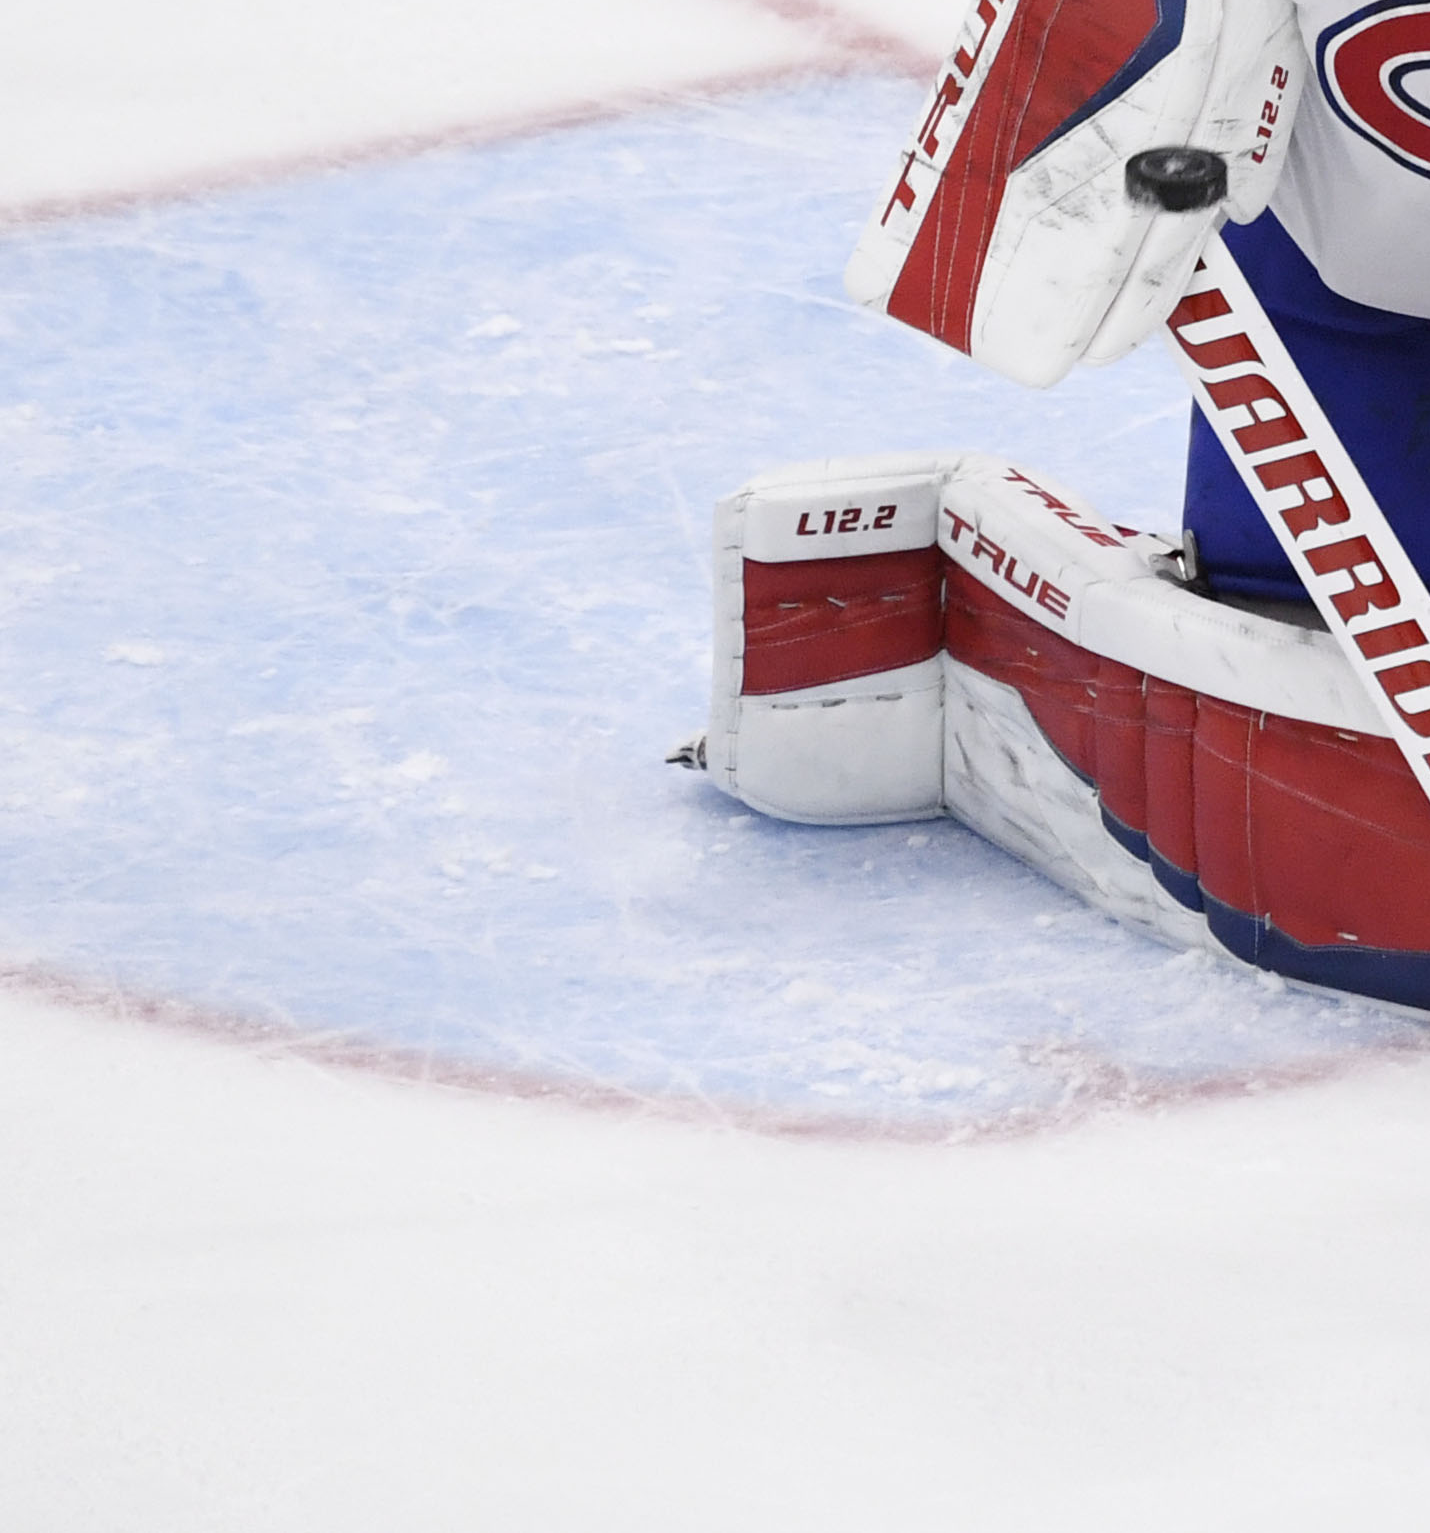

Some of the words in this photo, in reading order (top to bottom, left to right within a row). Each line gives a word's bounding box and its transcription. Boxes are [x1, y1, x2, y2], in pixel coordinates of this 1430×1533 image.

[1252, 64, 1289, 164] L12.2
[795, 503, 898, 537] L12.2
[1003, 467, 1128, 549] TRUE
[942, 506, 1072, 621] TRUE
